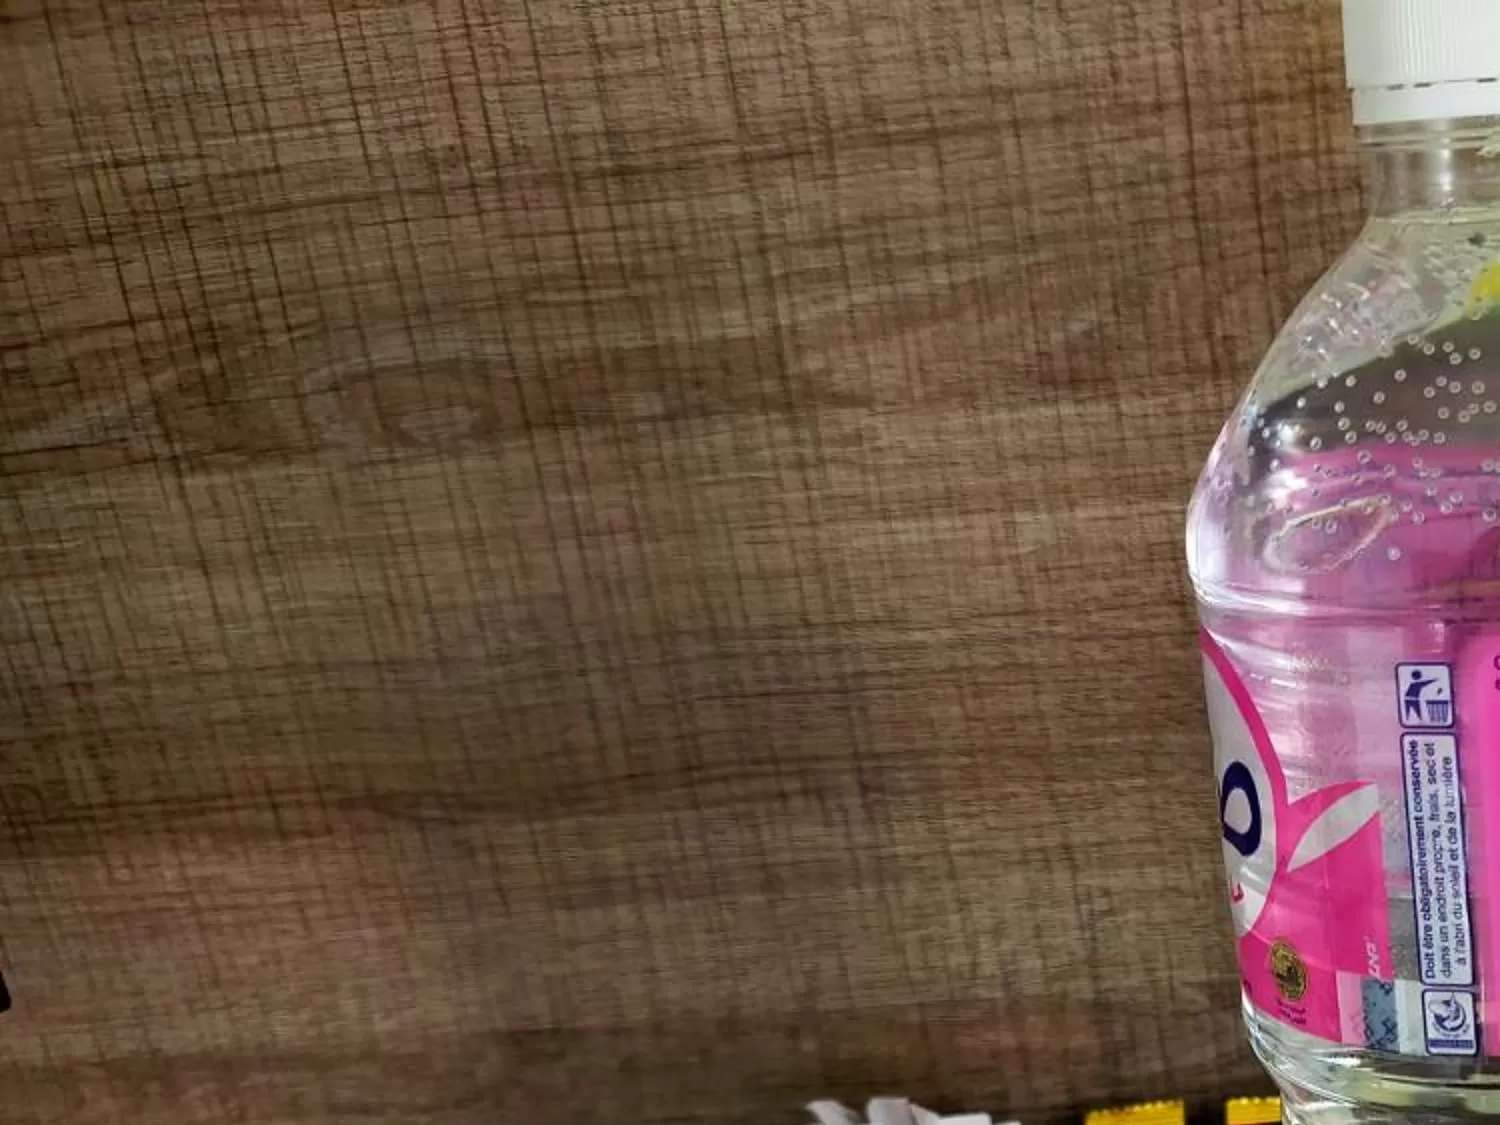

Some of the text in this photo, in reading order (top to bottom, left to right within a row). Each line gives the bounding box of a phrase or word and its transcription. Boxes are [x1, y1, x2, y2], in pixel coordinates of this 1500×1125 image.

[1424, 742, 1435, 757] et
[1426, 760, 1437, 785] sec
[1444, 811, 1456, 823] la
[1447, 827, 1458, 845] de
[1408, 740, 1436, 979] Doit être obligatoirement conservée
[1448, 847, 1459, 861] et
[1448, 865, 1461, 899] soleil
[1434, 876, 1448, 922] endroit
[1452, 903, 1463, 920] du
[1439, 926, 1449, 942] un
[1440, 945, 1452, 978] dans
